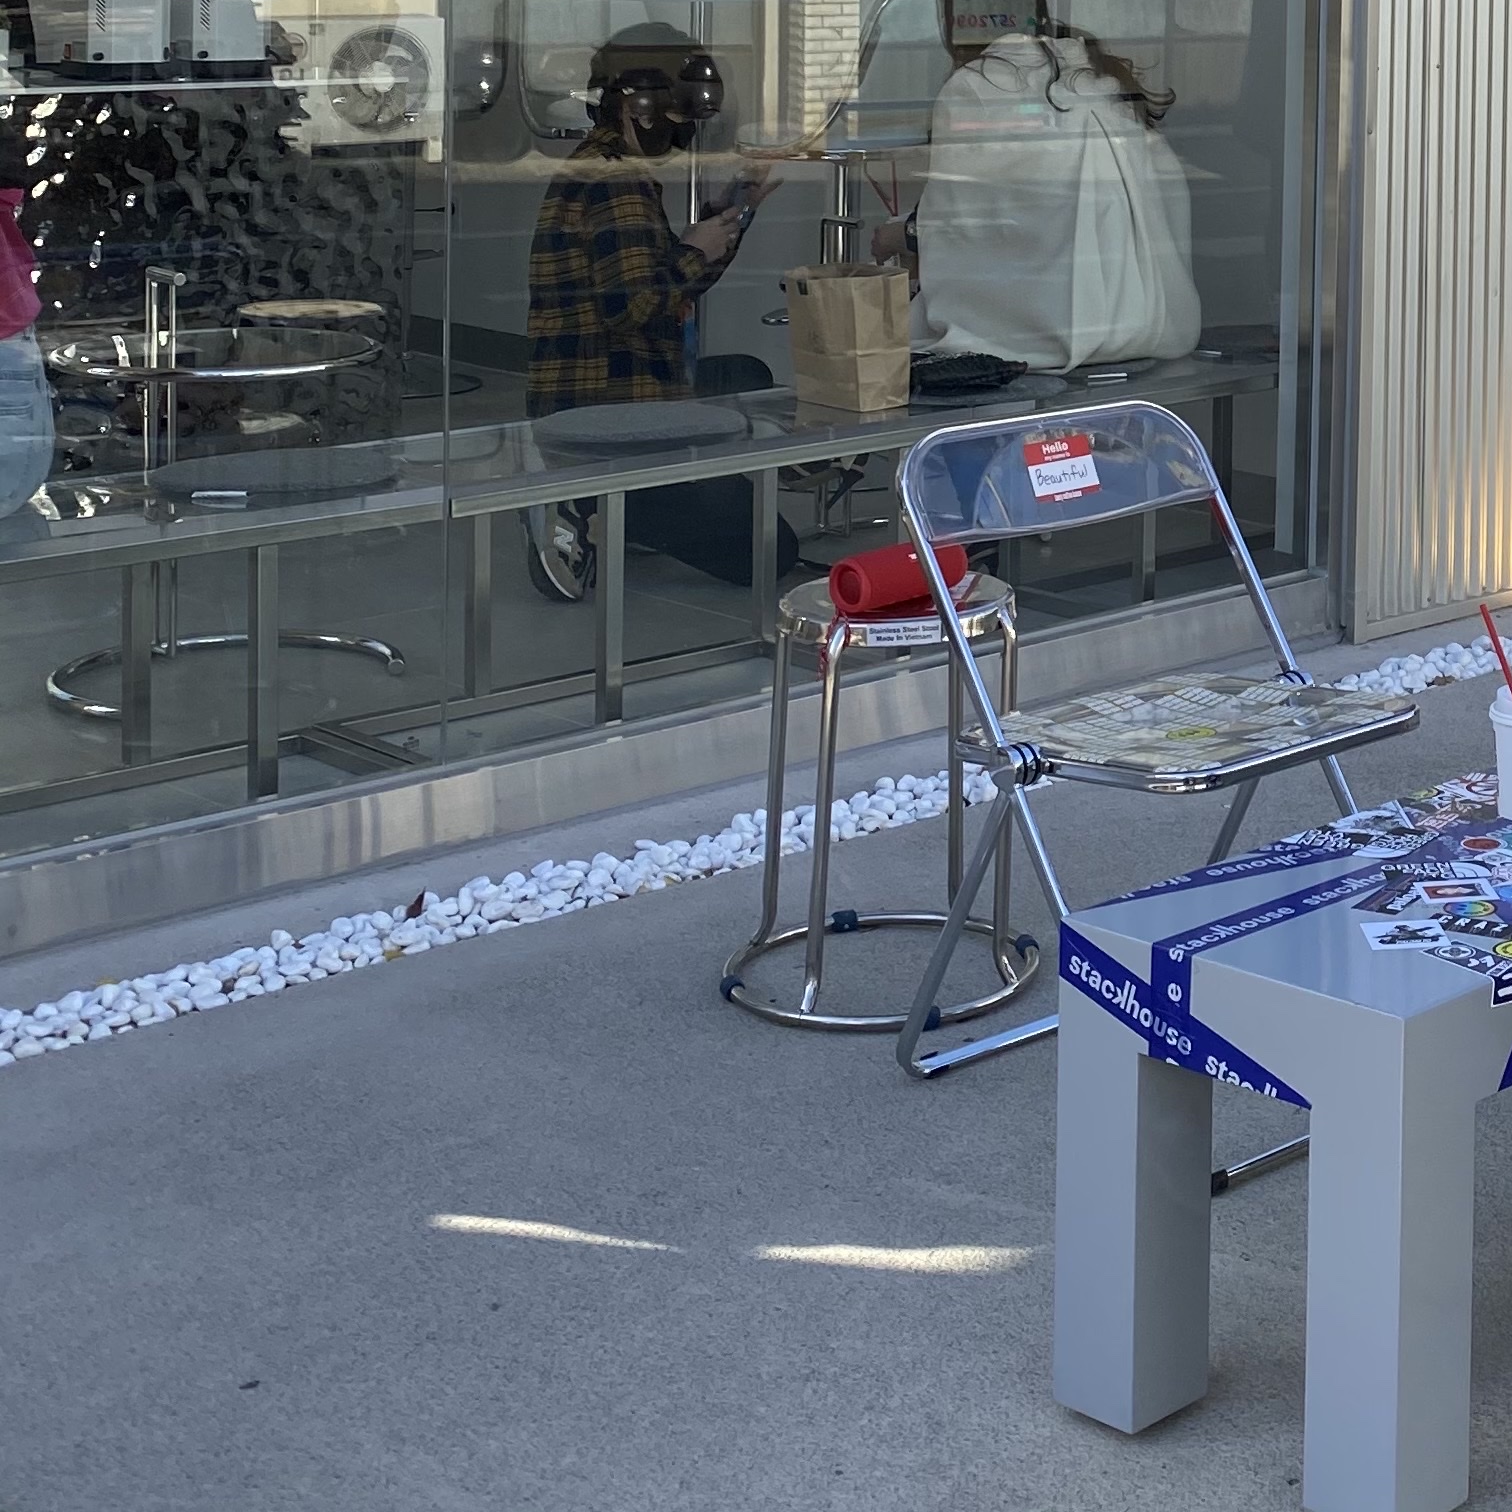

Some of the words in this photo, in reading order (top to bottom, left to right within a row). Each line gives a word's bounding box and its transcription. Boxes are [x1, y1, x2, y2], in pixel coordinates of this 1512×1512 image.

[1042, 441, 1068, 454] Hello
[1035, 464, 1087, 486] Beautiful
[1168, 905, 1296, 962] stackhouse
[1069, 954, 1192, 1056] stackhouse
